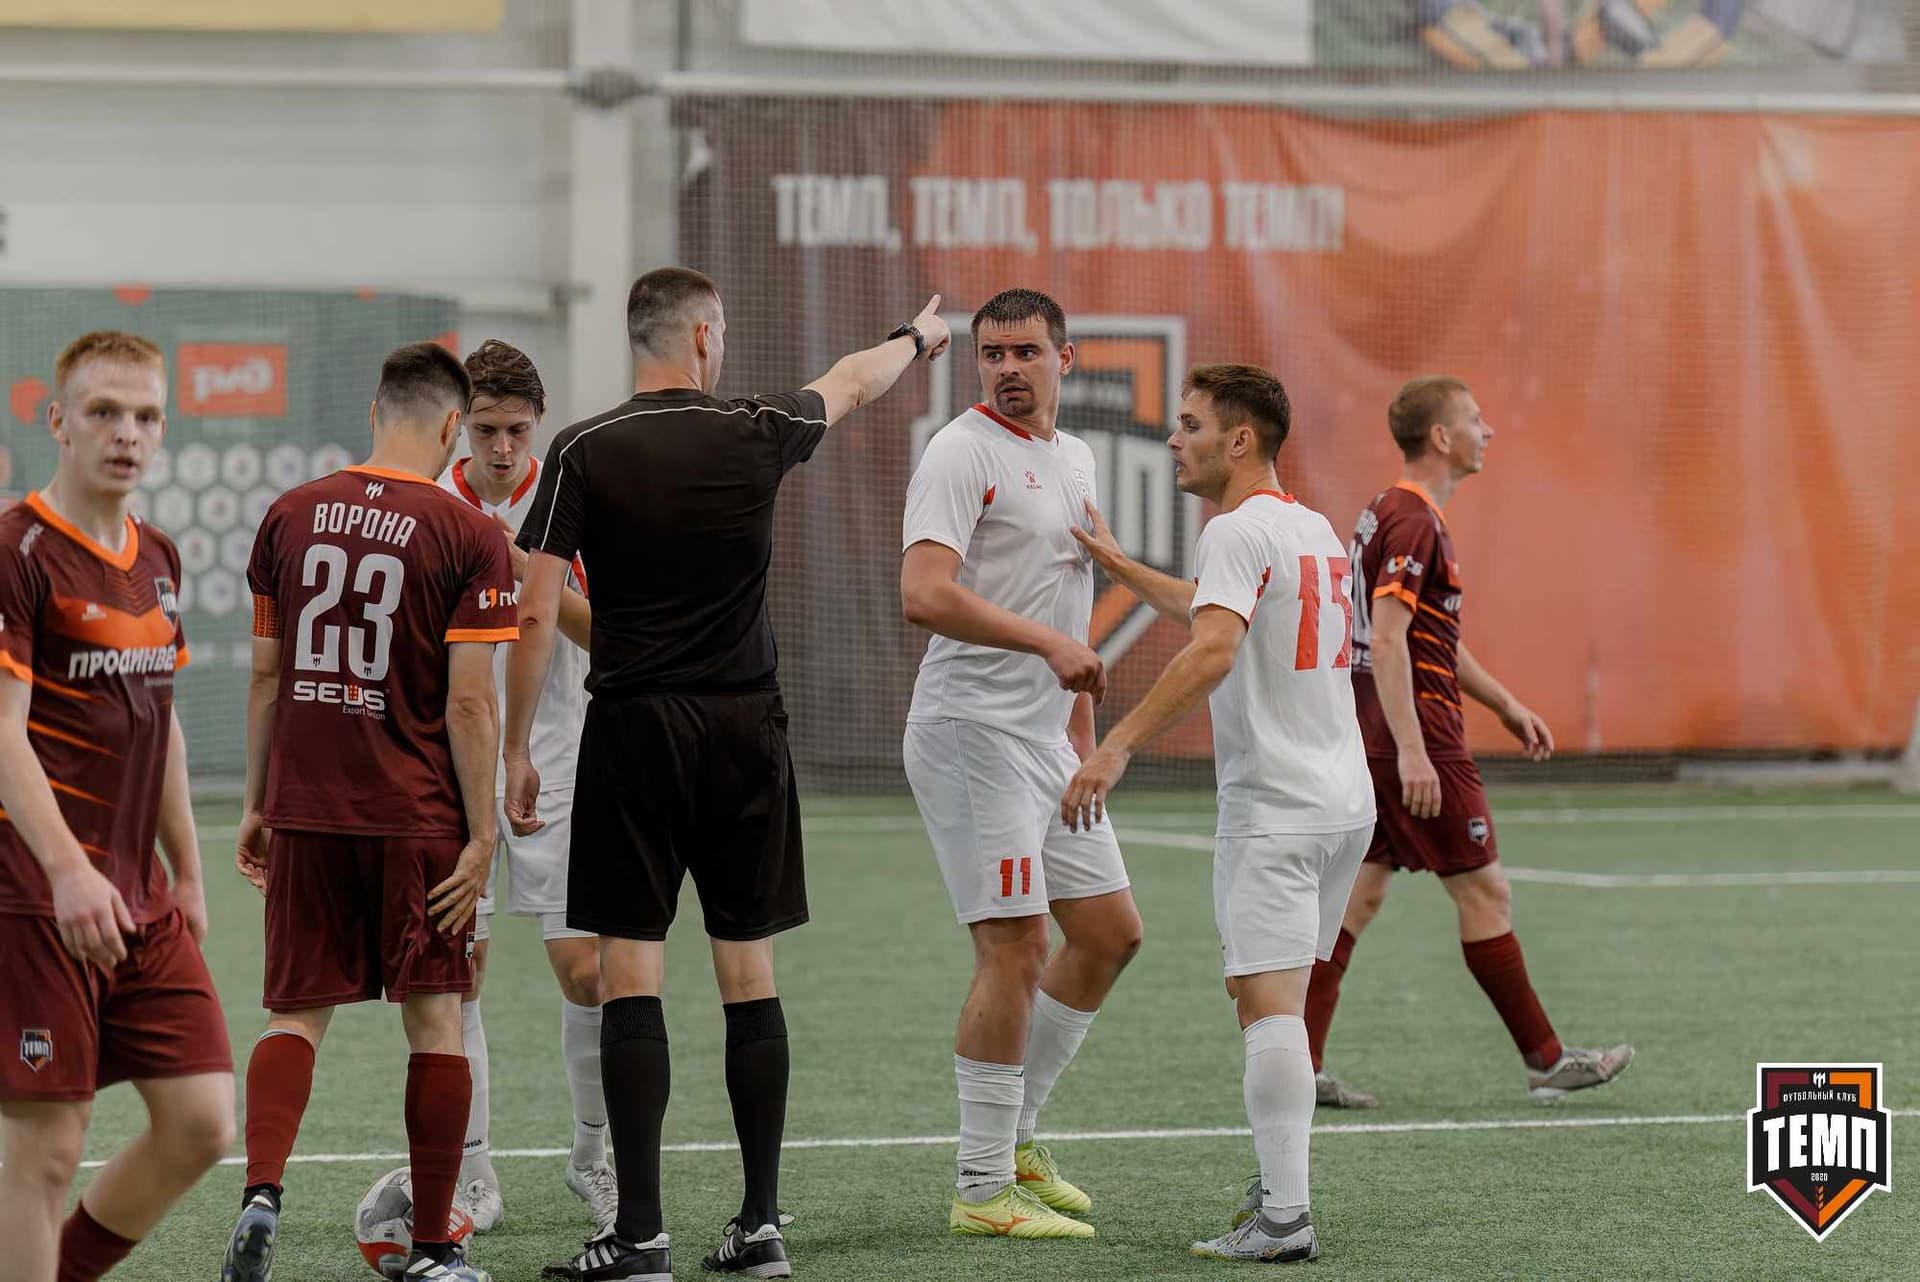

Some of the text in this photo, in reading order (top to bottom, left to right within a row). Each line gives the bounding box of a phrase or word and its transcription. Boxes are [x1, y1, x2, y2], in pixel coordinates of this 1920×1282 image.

[1049, 181, 1210, 250] ТОЛЬКО
[313, 502, 417, 548] ВОРОНА
[295, 543, 405, 682] 23
[1295, 554, 1352, 671] 15
[292, 680, 386, 712] SEUS
[999, 857, 1031, 898] 11
